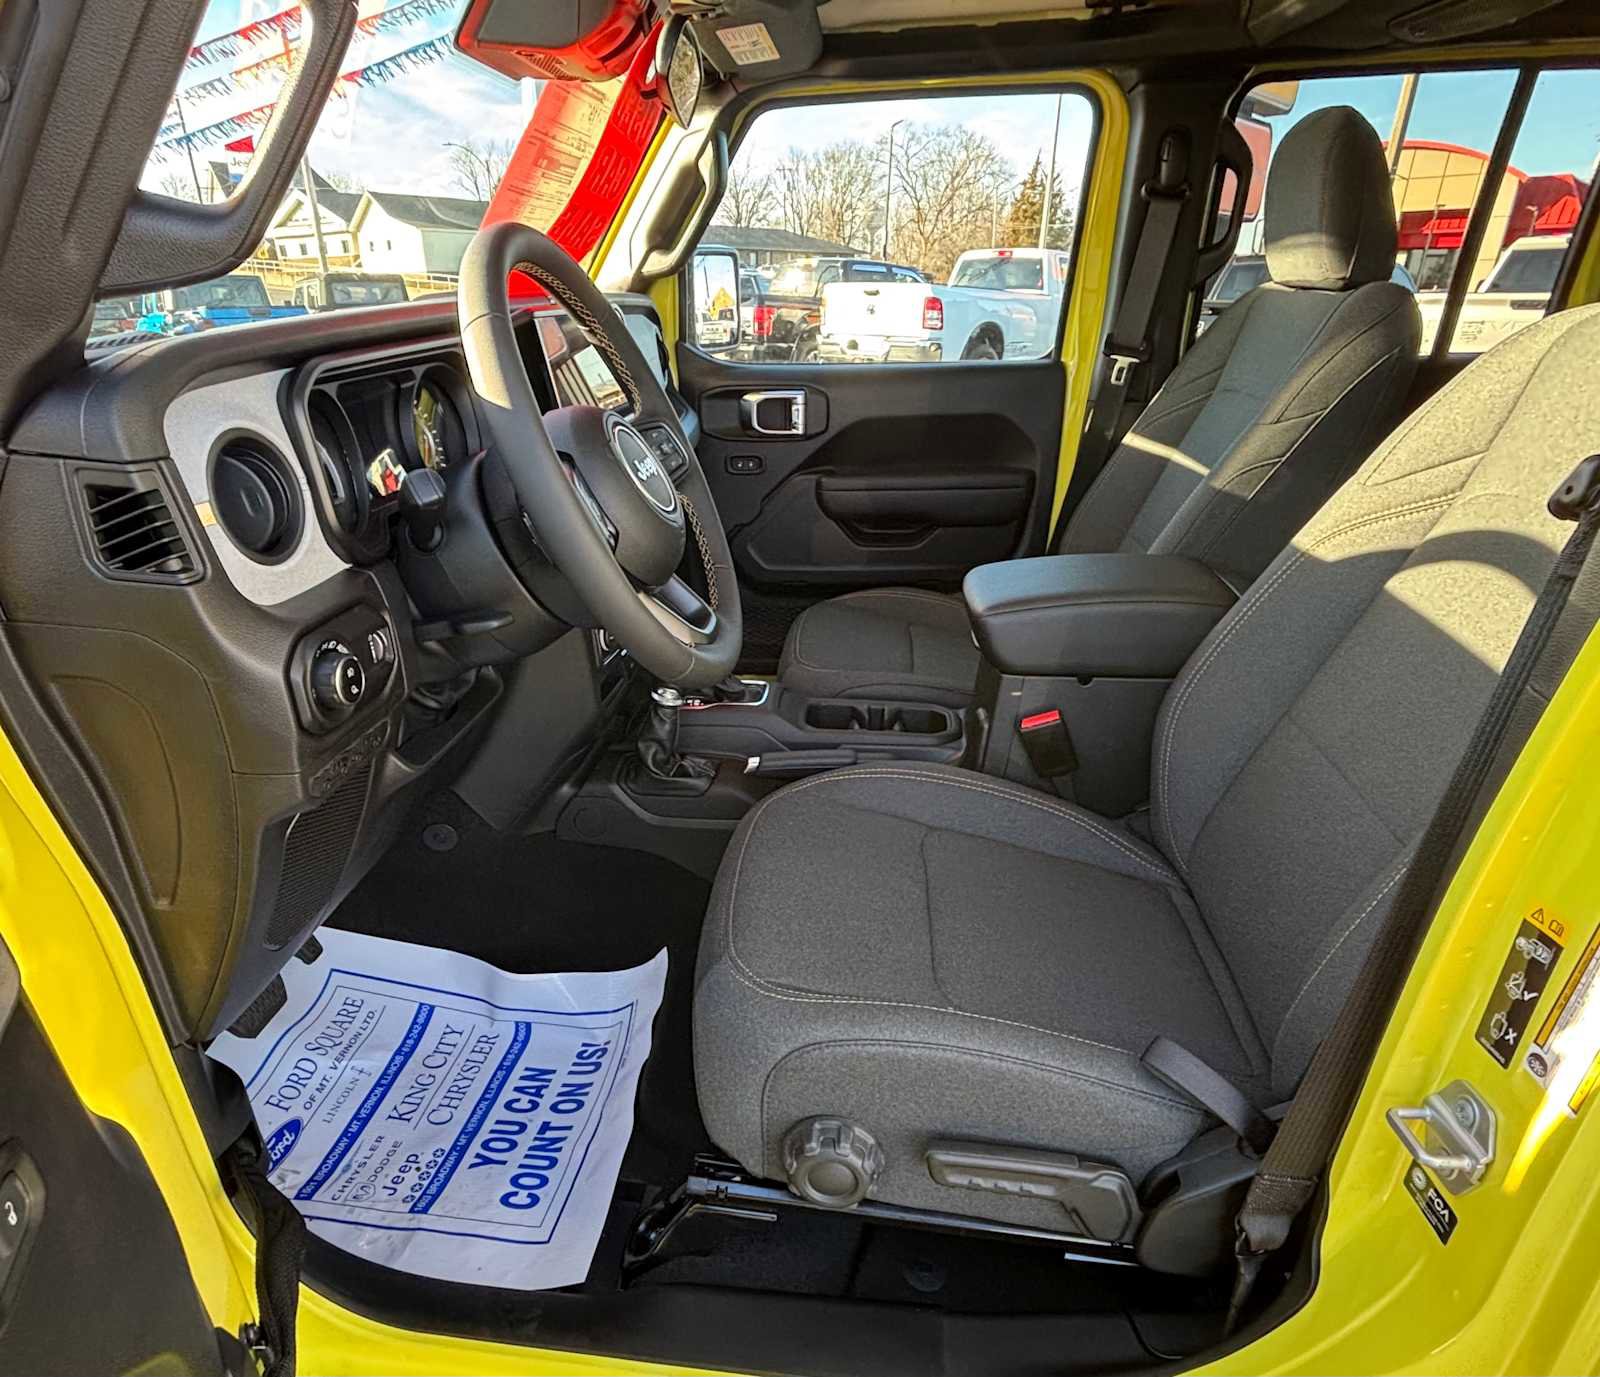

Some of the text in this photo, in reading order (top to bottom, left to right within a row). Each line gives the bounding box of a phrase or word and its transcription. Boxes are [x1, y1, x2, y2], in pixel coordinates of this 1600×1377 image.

[633, 456, 658, 481] Jeep
[264, 996, 364, 1112] FORD SQUARE
[303, 1009, 378, 1110] OF MT. VERNON LTD.
[385, 1023, 465, 1123] KING CITY
[426, 1033, 501, 1126] CHRYSLER
[313, 1136, 350, 1181] BROADWAY
[382, 1054, 404, 1085] ILLINOIS
[322, 1077, 361, 1124] LINCOLN
[467, 1066, 557, 1170] YOU CAN
[500, 1040, 612, 1210] COUNT ON US!
[331, 1135, 385, 1201] CHRYSLER
[367, 1140, 403, 1183] DODGE
[382, 1153, 421, 1197] Jeep
[427, 1150, 459, 1199] BROADWAY
[1427, 1187, 1450, 1222] FCA
